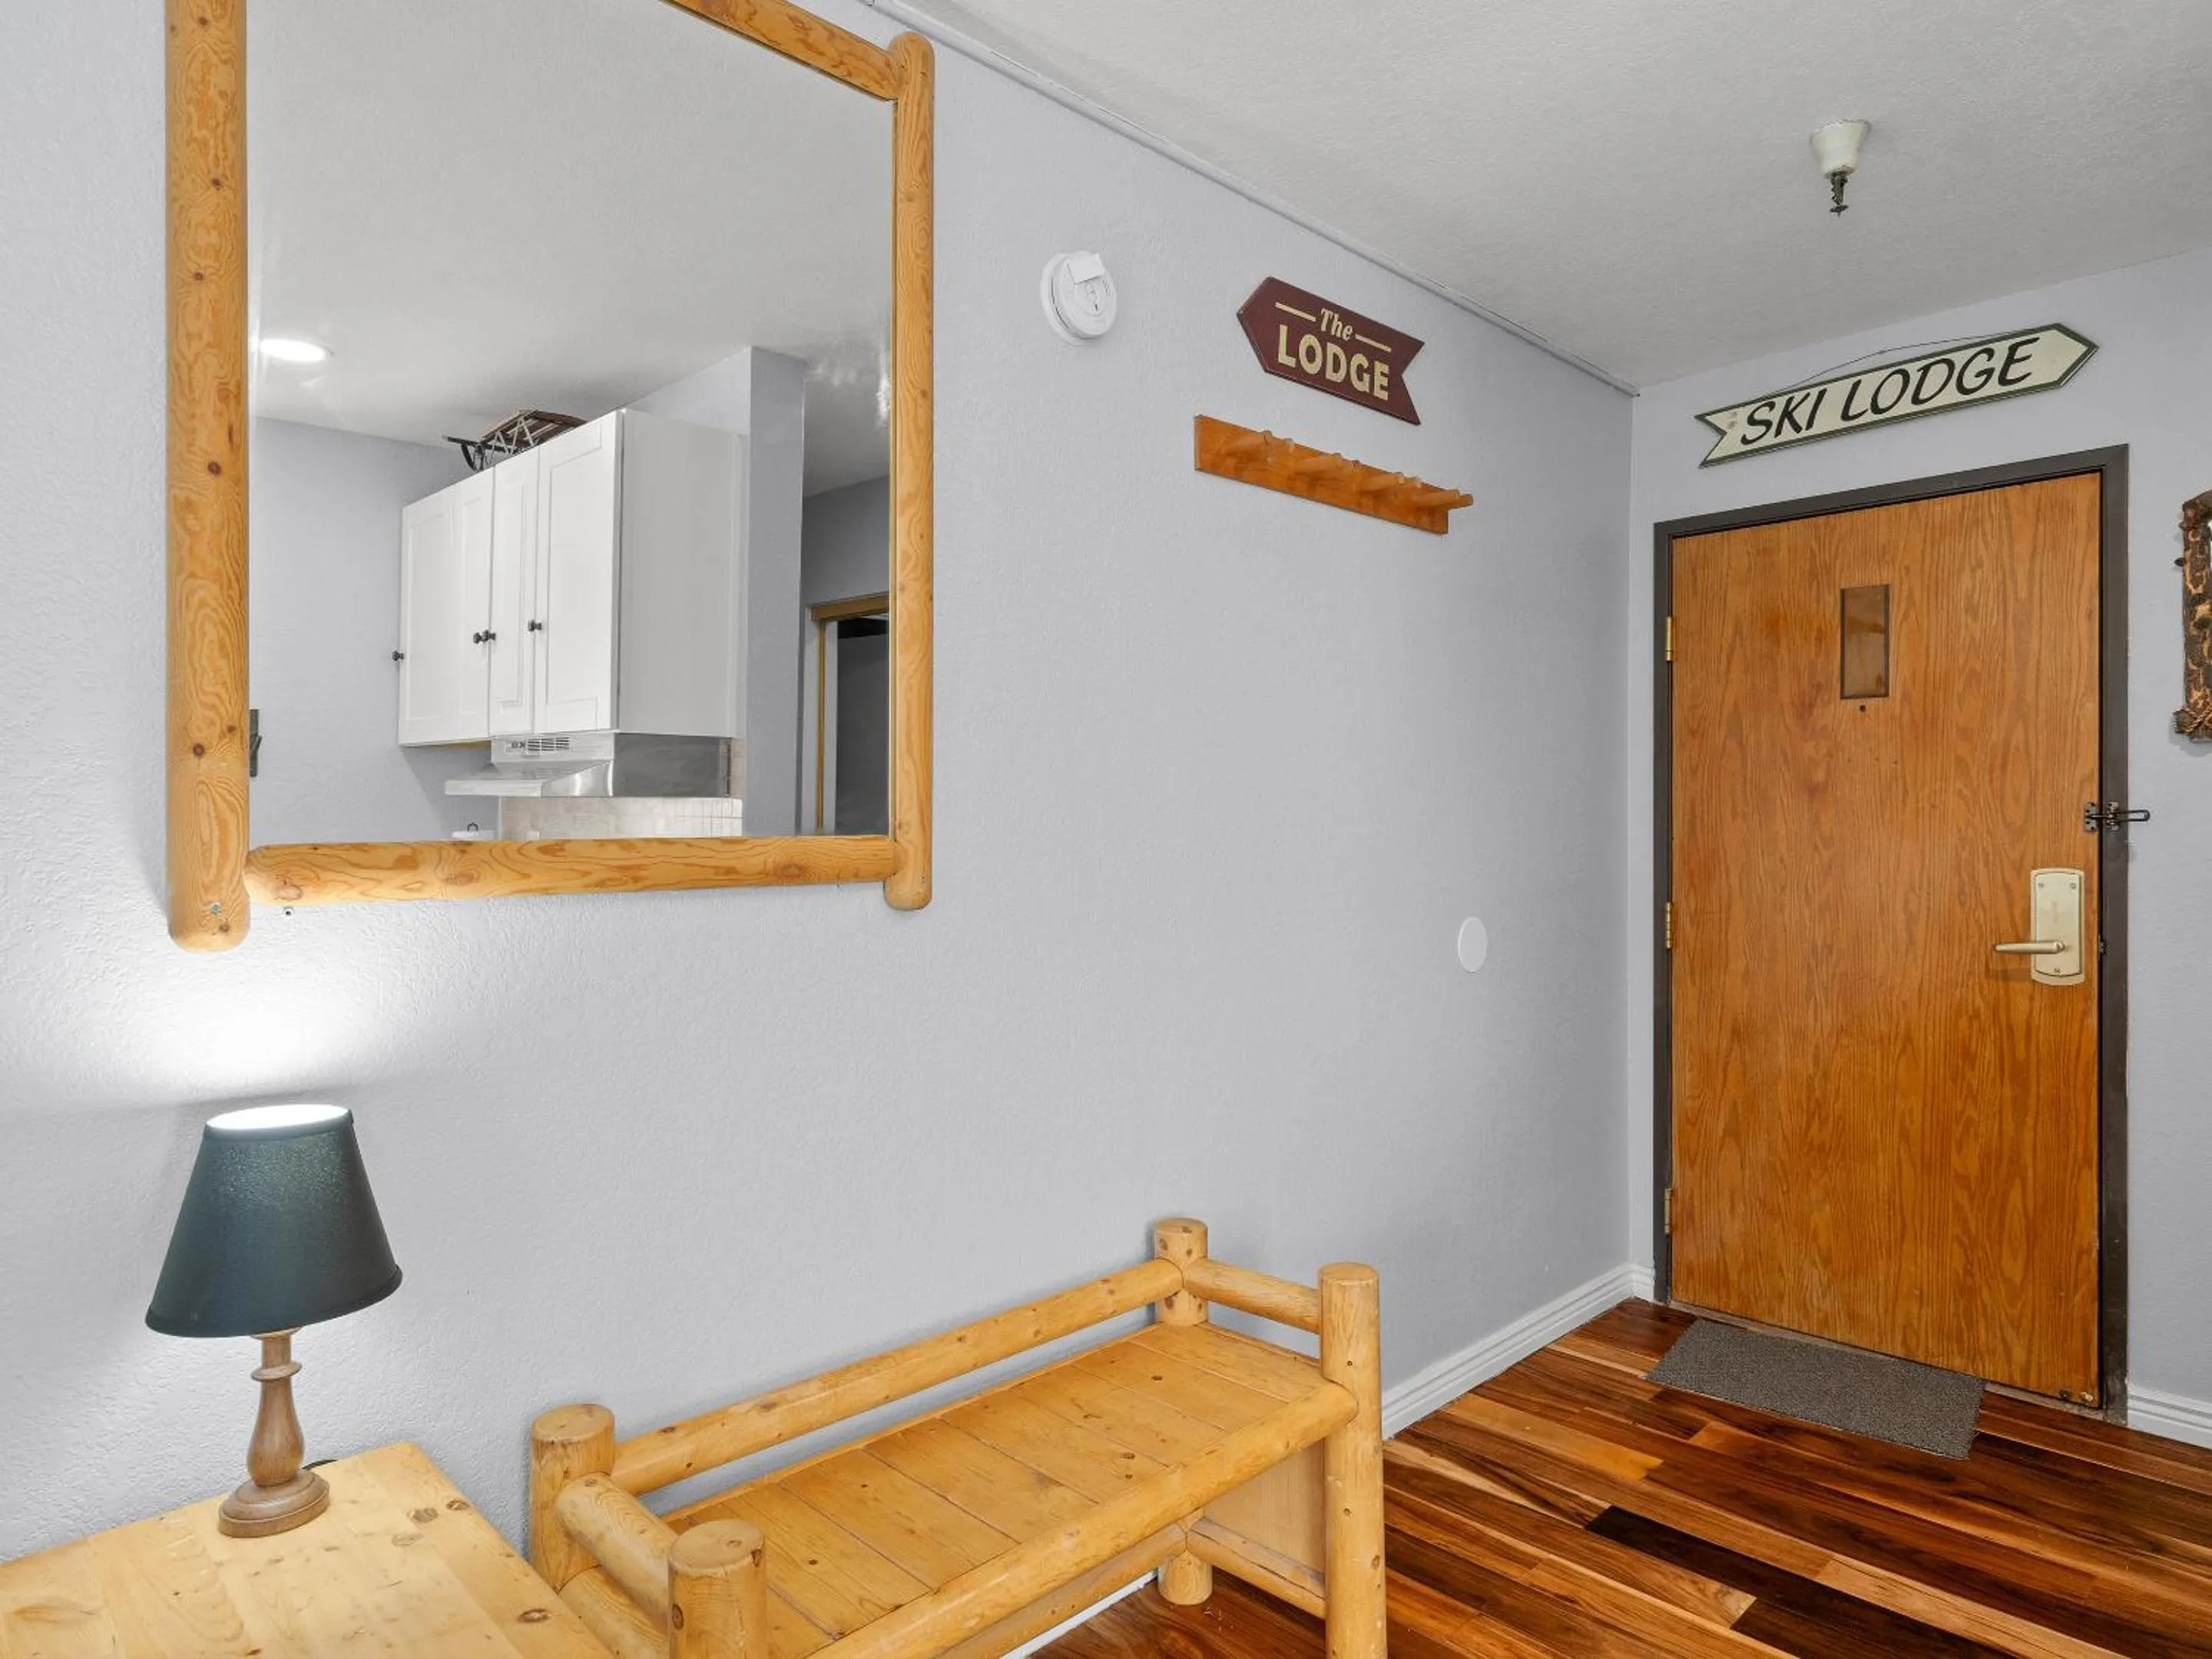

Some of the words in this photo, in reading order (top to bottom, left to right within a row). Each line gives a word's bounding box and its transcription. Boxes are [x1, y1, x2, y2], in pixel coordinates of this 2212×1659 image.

[1278, 324, 1389, 401] LODGE
[1320, 308, 1353, 341] The
[1740, 388, 1827, 445] SKI
[1840, 337, 2040, 422] LODGE
